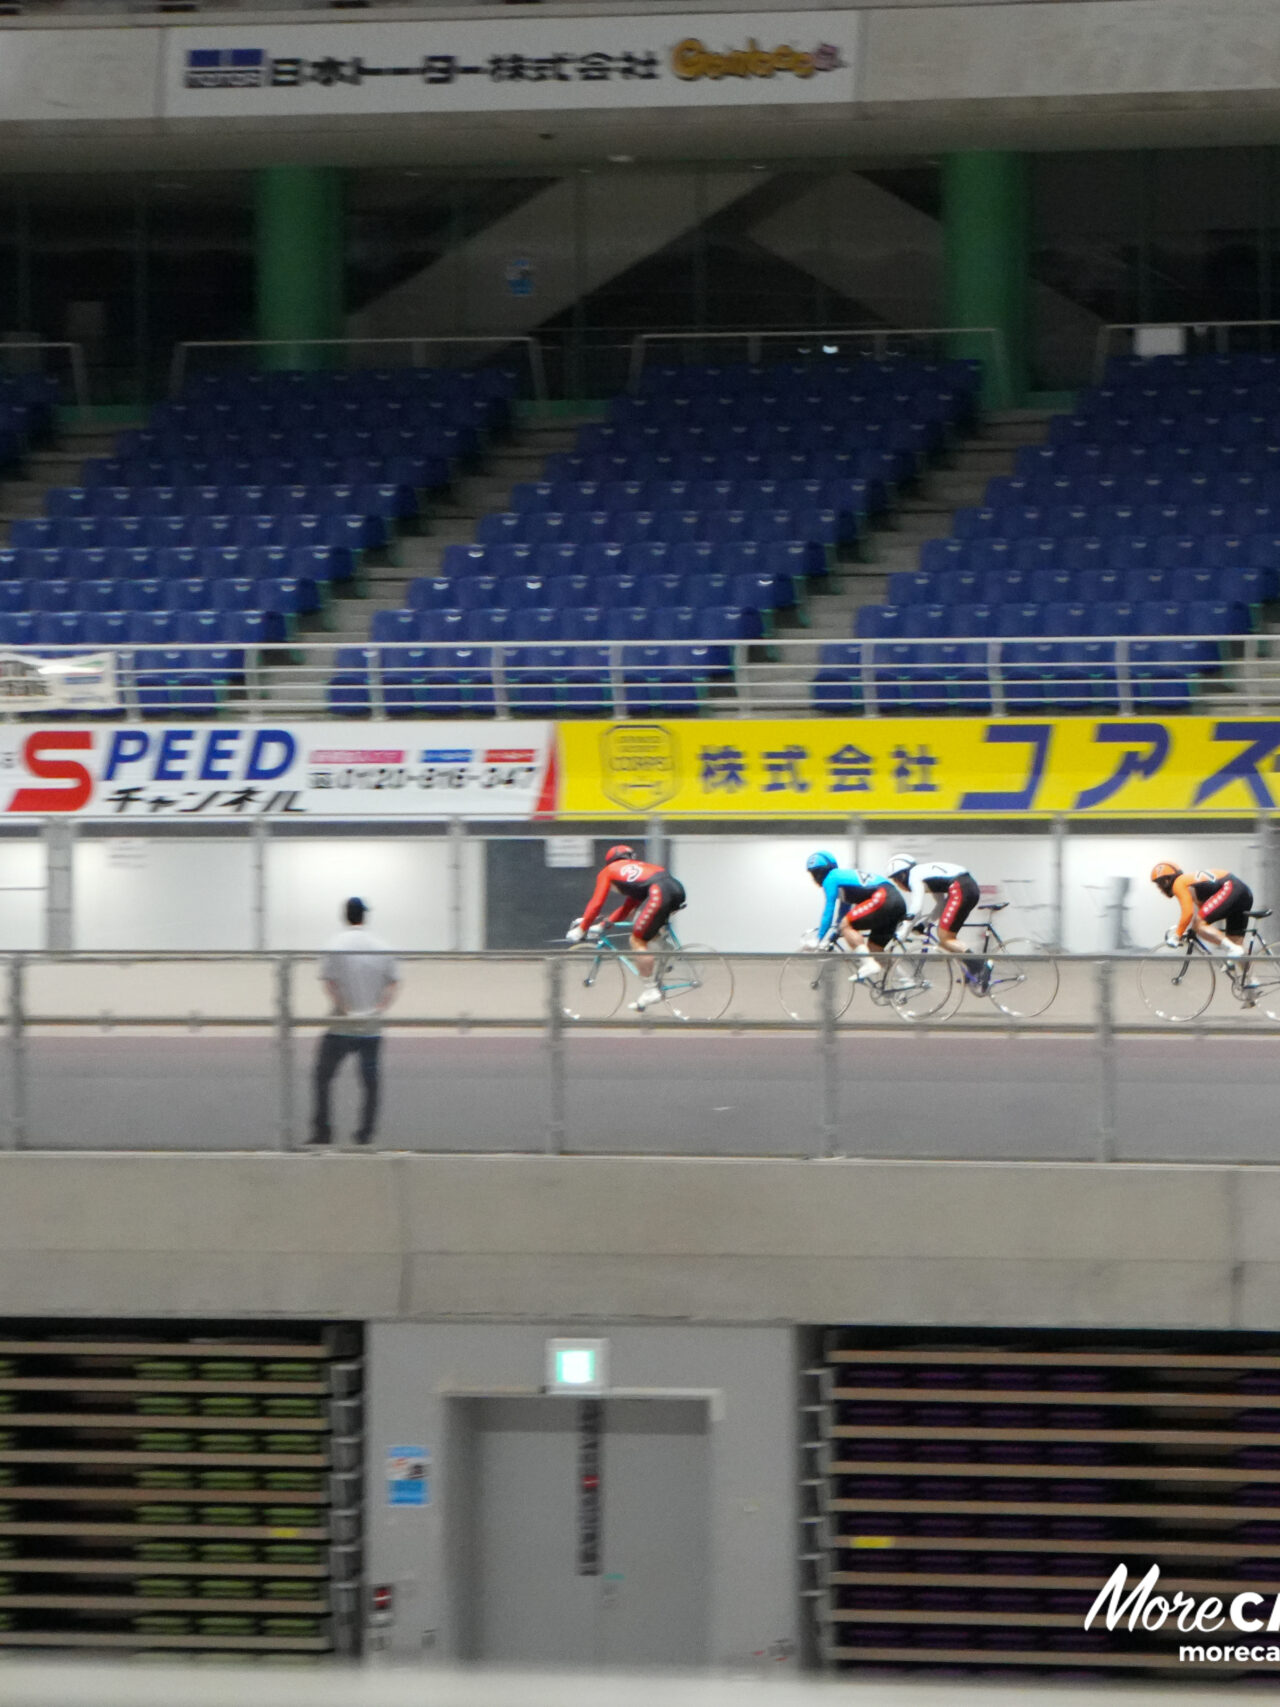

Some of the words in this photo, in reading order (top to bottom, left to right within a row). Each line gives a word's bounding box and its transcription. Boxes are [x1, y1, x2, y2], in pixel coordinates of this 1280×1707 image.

[6, 729, 298, 812] SPEED
[695, 743, 940, 794] 株式会社
[103, 785, 307, 814] チャンネル
[620, 863, 644, 883] 3
[1195, 868, 1217, 884] 7
